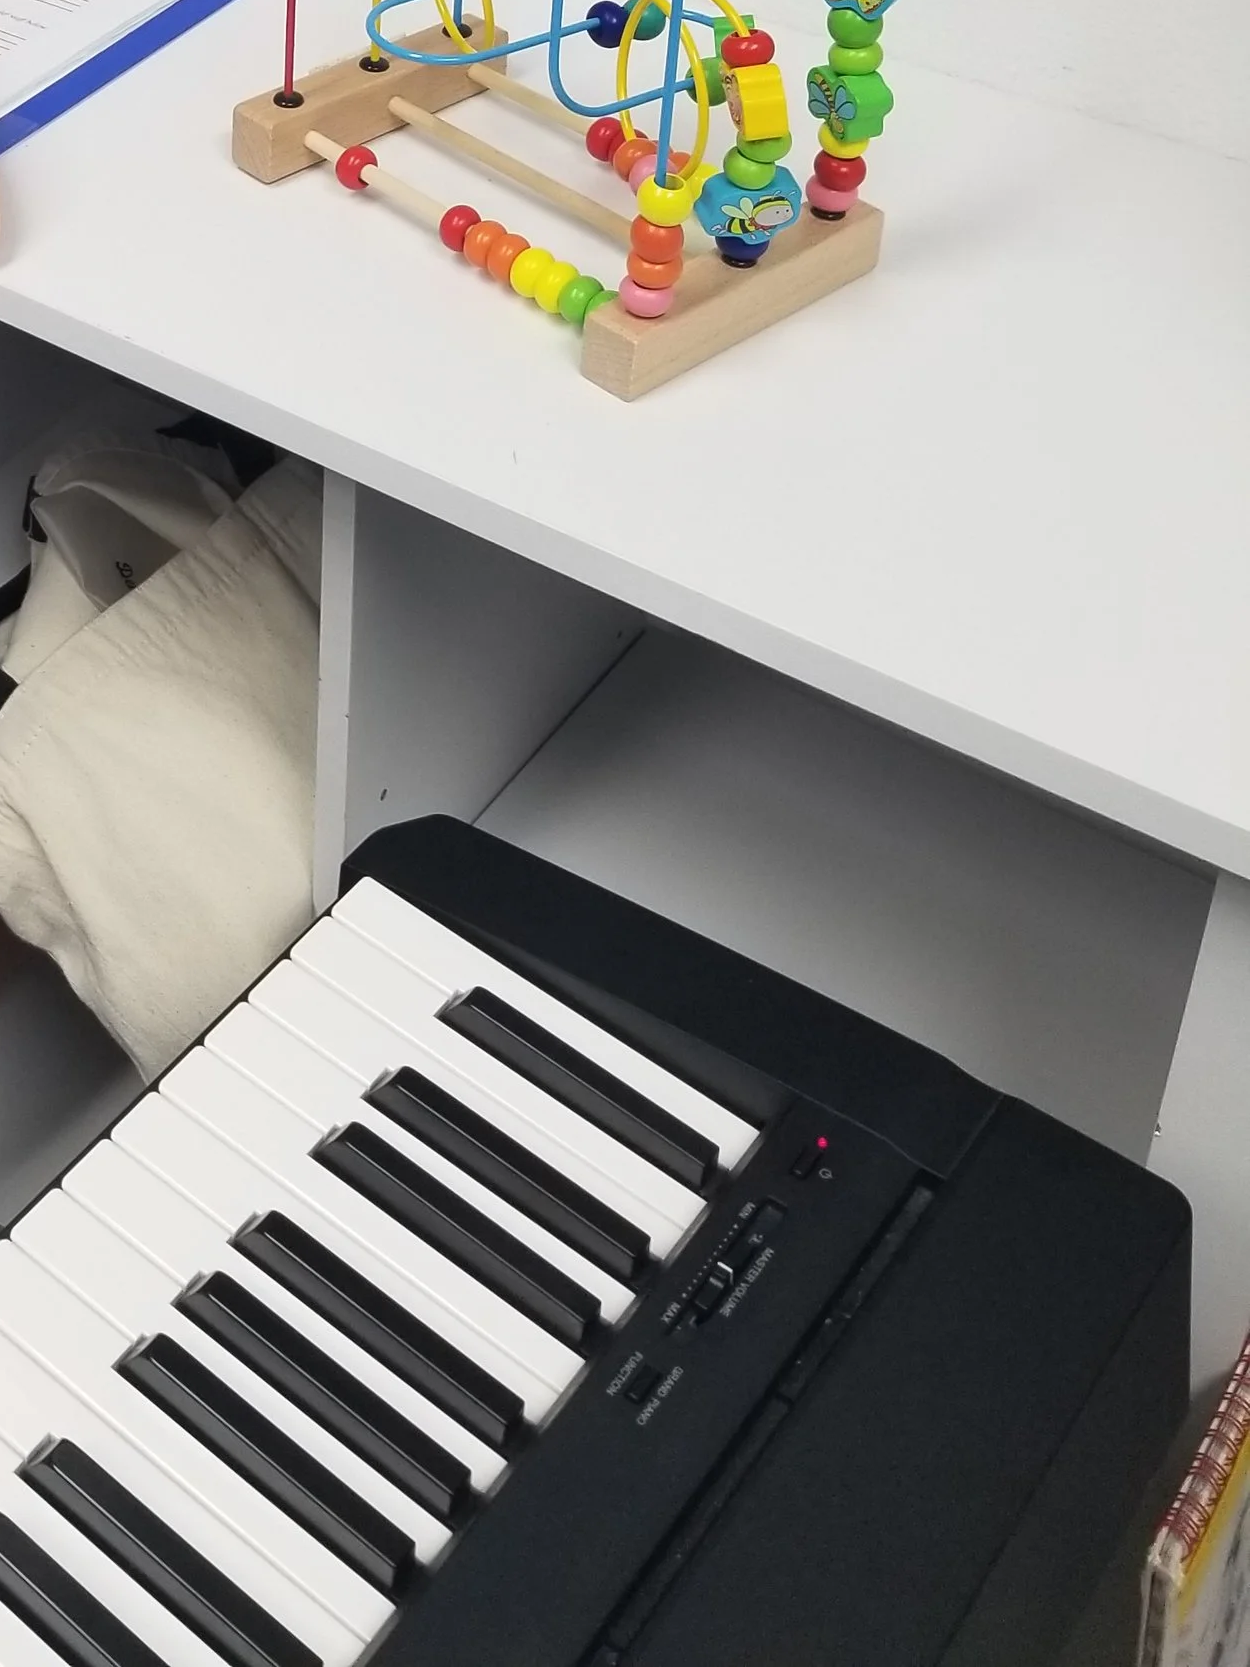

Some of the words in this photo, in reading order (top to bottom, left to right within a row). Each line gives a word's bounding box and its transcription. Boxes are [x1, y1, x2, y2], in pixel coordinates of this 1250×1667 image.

[743, 1247, 776, 1285] MASTER
[719, 1281, 750, 1318] VOLUME
[606, 1350, 645, 1397] FUNCTION
[657, 1366, 685, 1398] GRAND
[635, 1397, 661, 1427] PIANO
